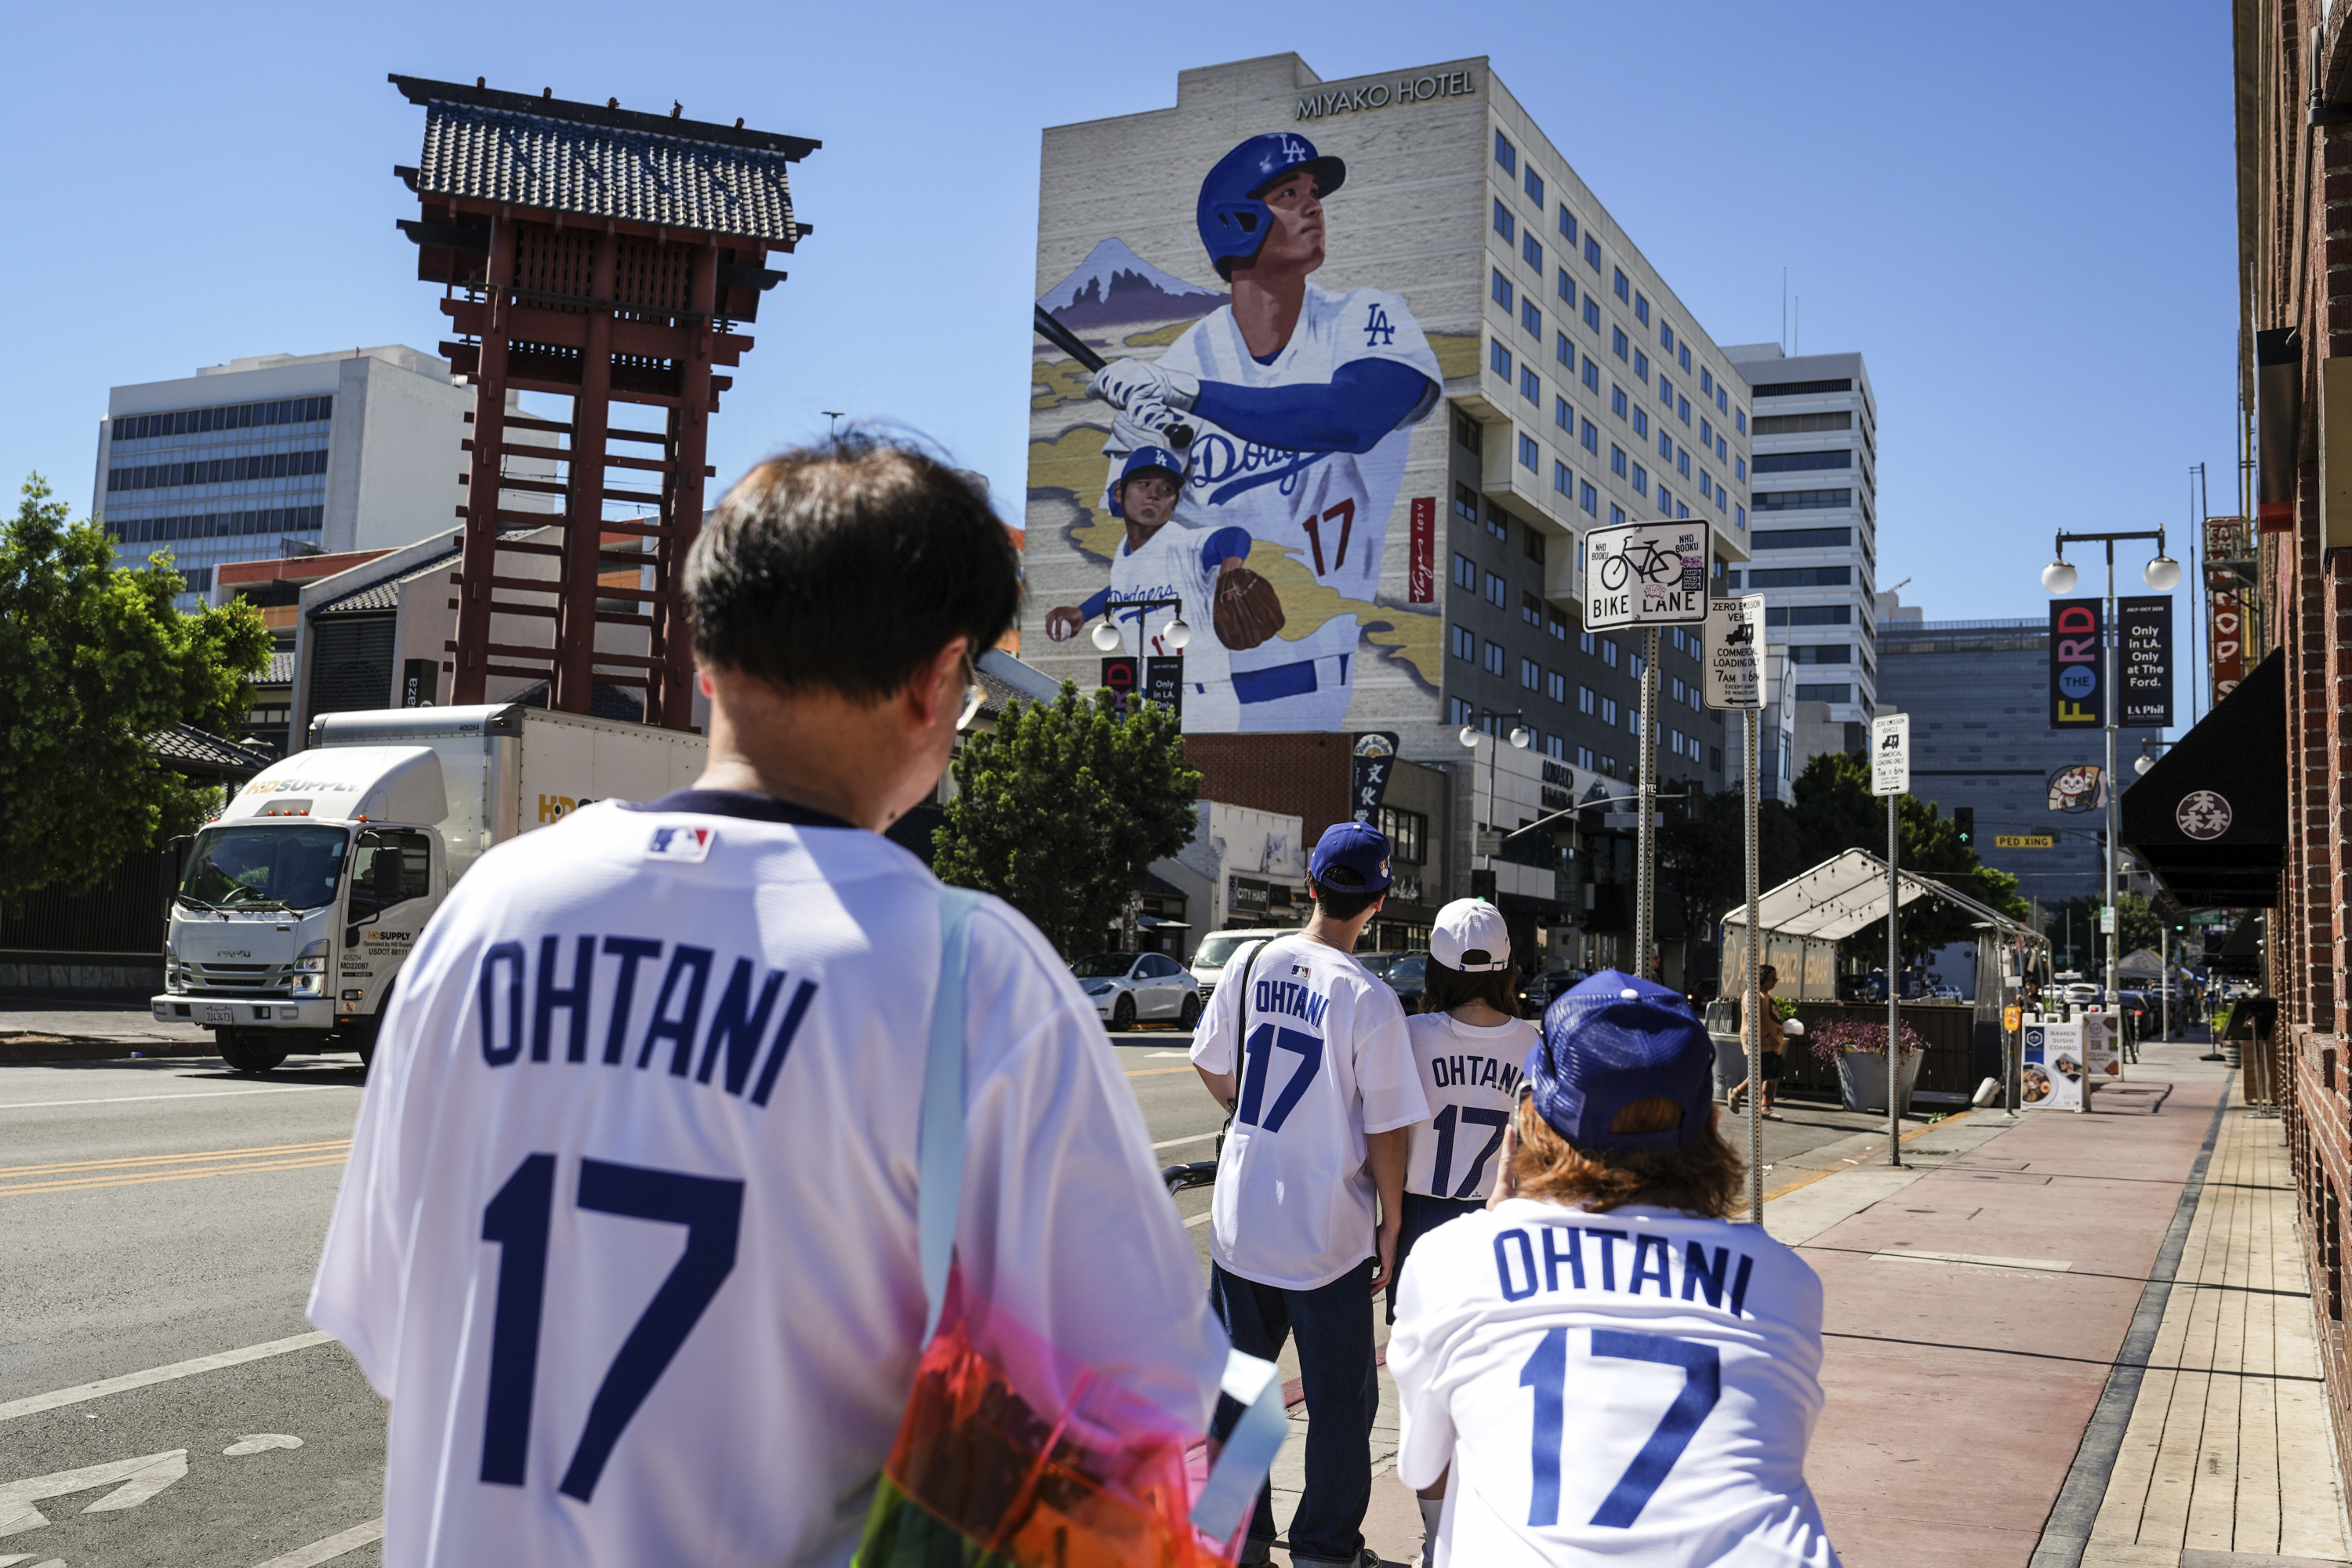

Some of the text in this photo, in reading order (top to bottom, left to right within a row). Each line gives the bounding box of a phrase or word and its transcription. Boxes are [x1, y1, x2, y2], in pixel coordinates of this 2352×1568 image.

[1296, 71, 1474, 121] MIYAKO HOTEL
[1279, 133, 1306, 163] LA
[1363, 303, 1396, 347] LA
[1302, 497, 1355, 577] 17
[1679, 534, 1694, 543] NHD
[1595, 543, 1606, 552] NHD
[1675, 543, 1699, 554] BOOKU
[1593, 594, 1628, 618] BIKE
[1643, 591, 1695, 612] LANE
[1712, 602, 1736, 611] ZERO
[2132, 626, 2158, 637] Only
[2129, 639, 2161, 648] in LA.
[1717, 648, 1758, 657] COMMERCIAL
[2132, 652, 2159, 662] Only
[1713, 658, 1760, 667] LOADING ONLY
[2127, 664, 2164, 674] at The
[1156, 680, 1174, 690] Only
[2064, 676, 2090, 688] THE
[2130, 677, 2161, 687] Ford.
[2127, 704, 2164, 714] LA Phil
[1999, 837, 2049, 847] PED XING
[1256, 980, 1330, 1029] OHTANI
[207, 1012, 230, 1022] 31434T3
[479, 934, 819, 1110] OHTANI
[1240, 1022, 1323, 1133] 17
[1432, 1104, 1510, 1199] 17
[1493, 1227, 1753, 1319] OHTANI
[480, 1152, 746, 1505] 17
[1519, 1327, 1721, 1529] 17
